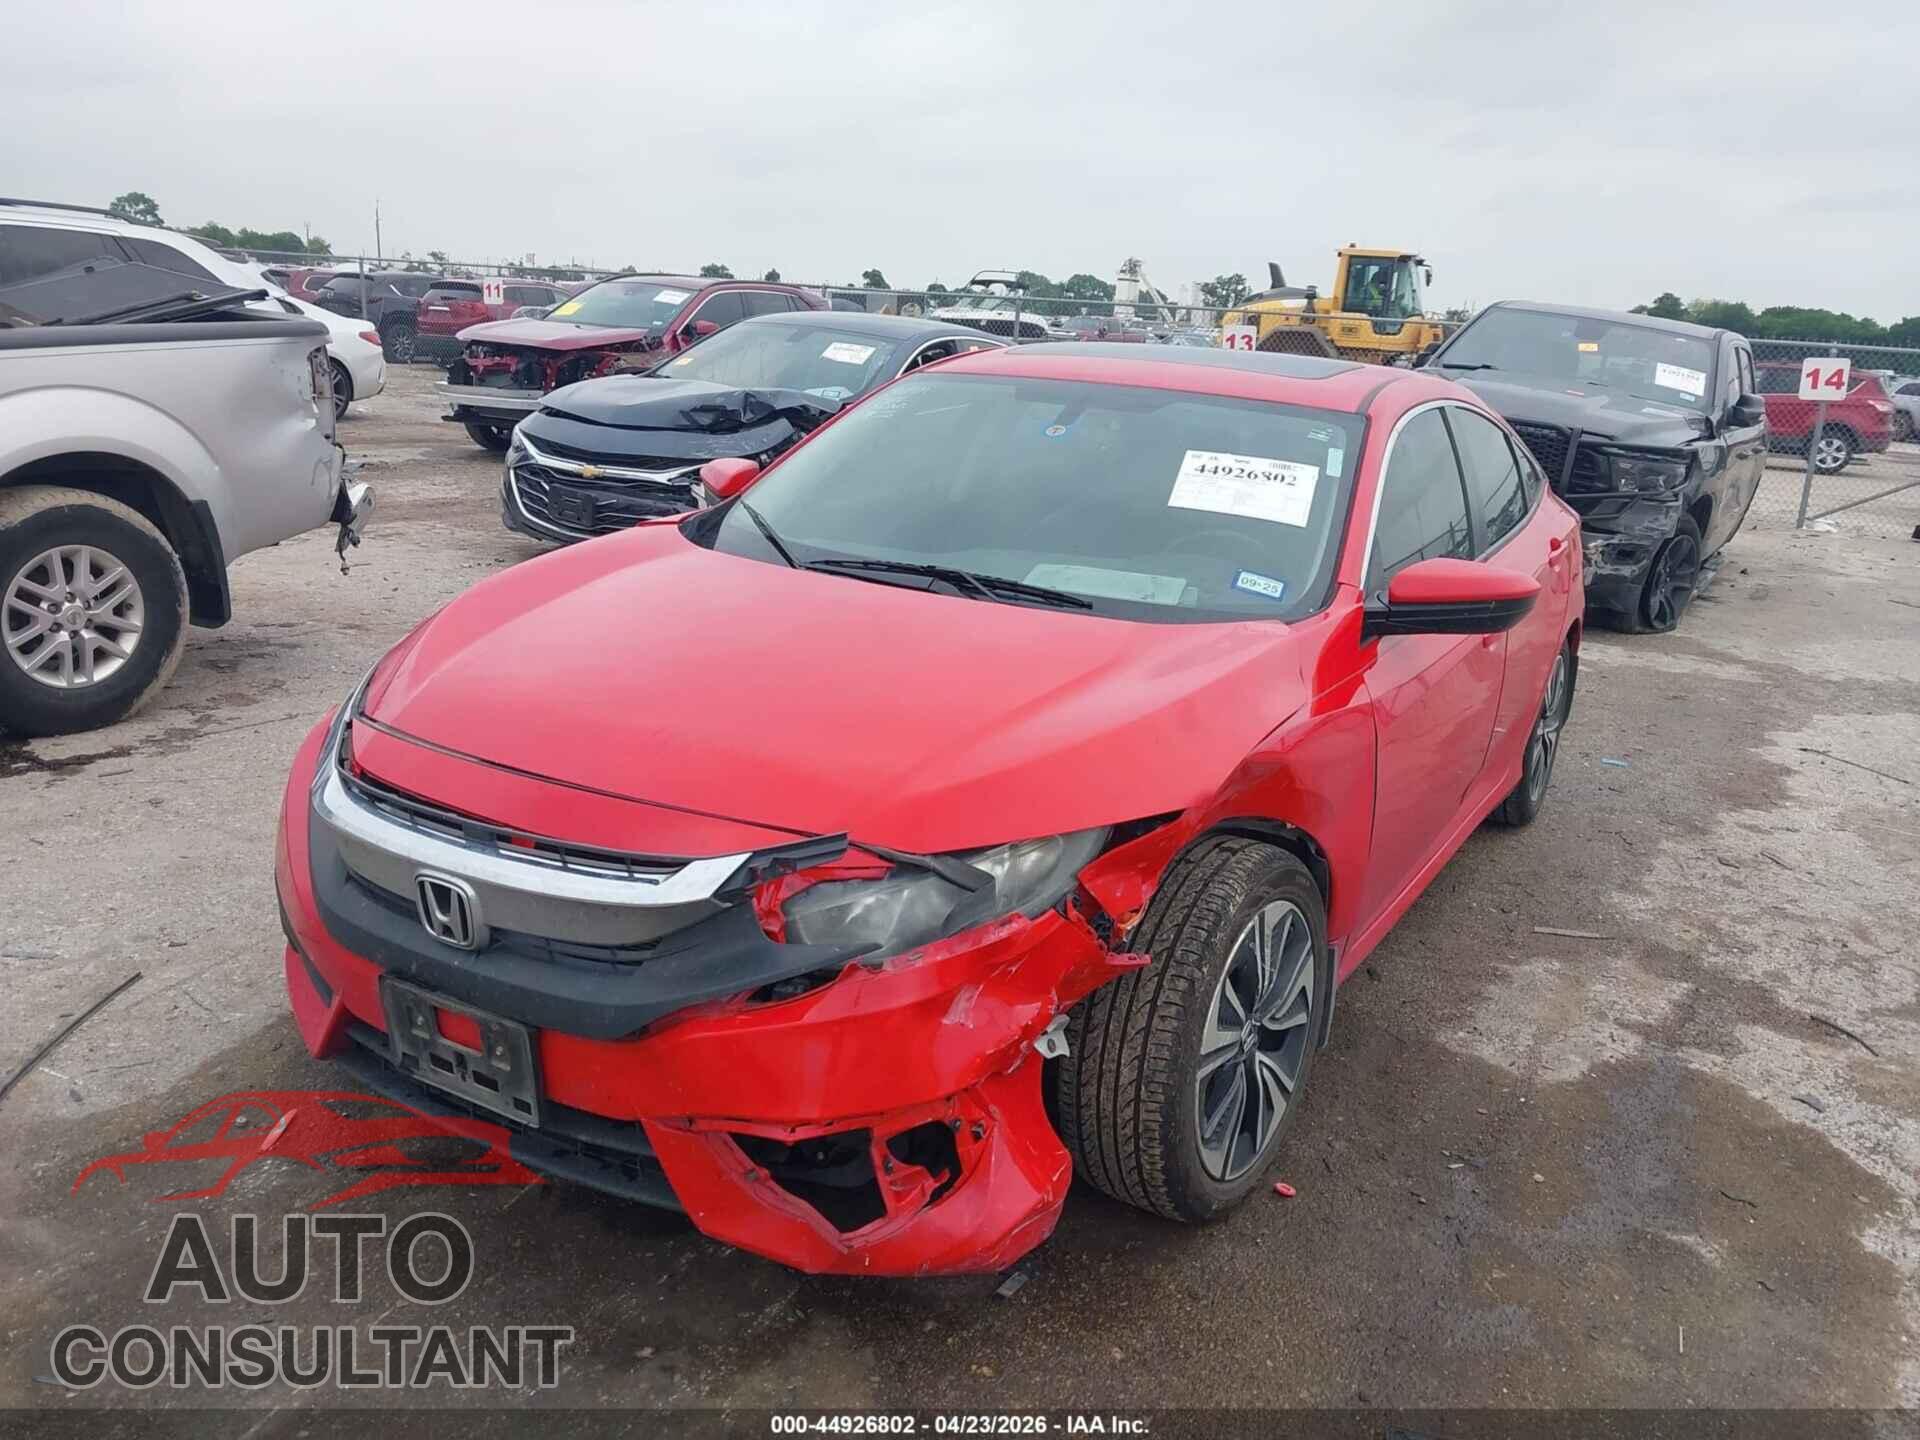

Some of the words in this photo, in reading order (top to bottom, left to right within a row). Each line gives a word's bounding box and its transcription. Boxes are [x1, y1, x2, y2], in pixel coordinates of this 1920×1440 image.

[485, 283, 500, 298] 11
[1225, 333, 1254, 351] 13
[1806, 367, 1846, 390] 14
[1194, 463, 1297, 487] 44926802
